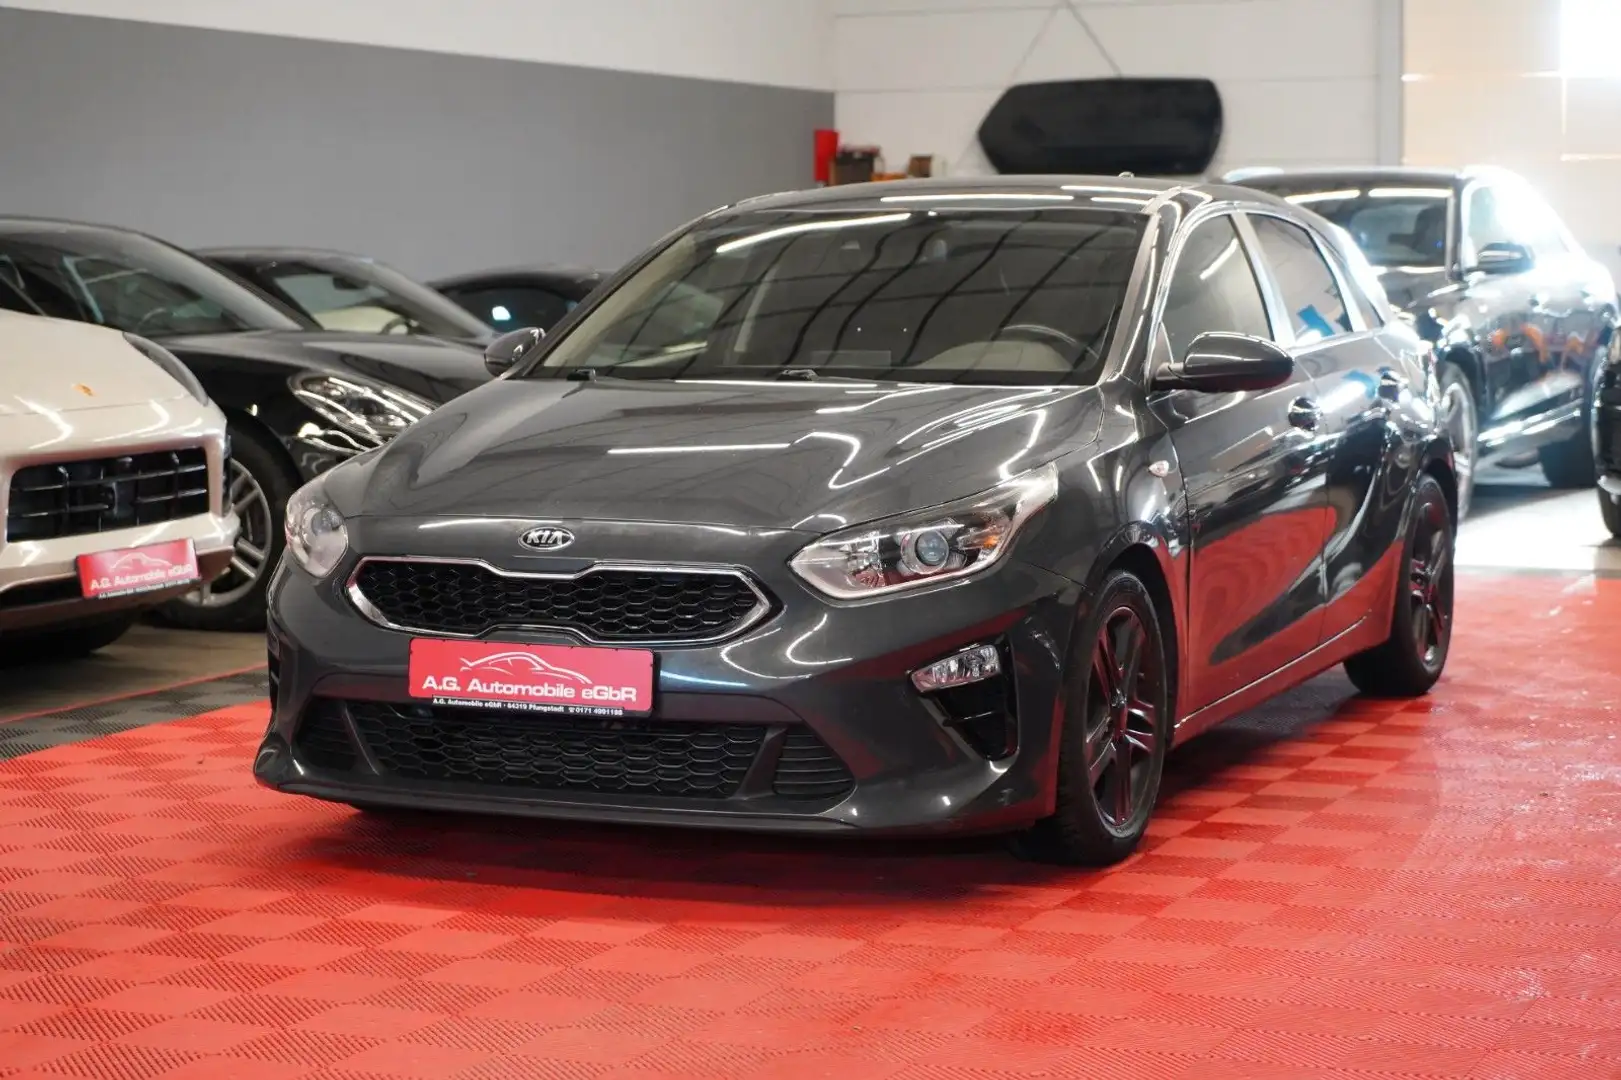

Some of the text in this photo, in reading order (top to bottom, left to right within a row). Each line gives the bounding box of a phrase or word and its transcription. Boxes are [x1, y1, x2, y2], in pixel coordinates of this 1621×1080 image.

[526, 530, 563, 545] KIA
[422, 675, 637, 702] A.G. Automobile eGbR
[447, 699, 483, 708] Automobile
[529, 703, 565, 713] Pfungstadt
